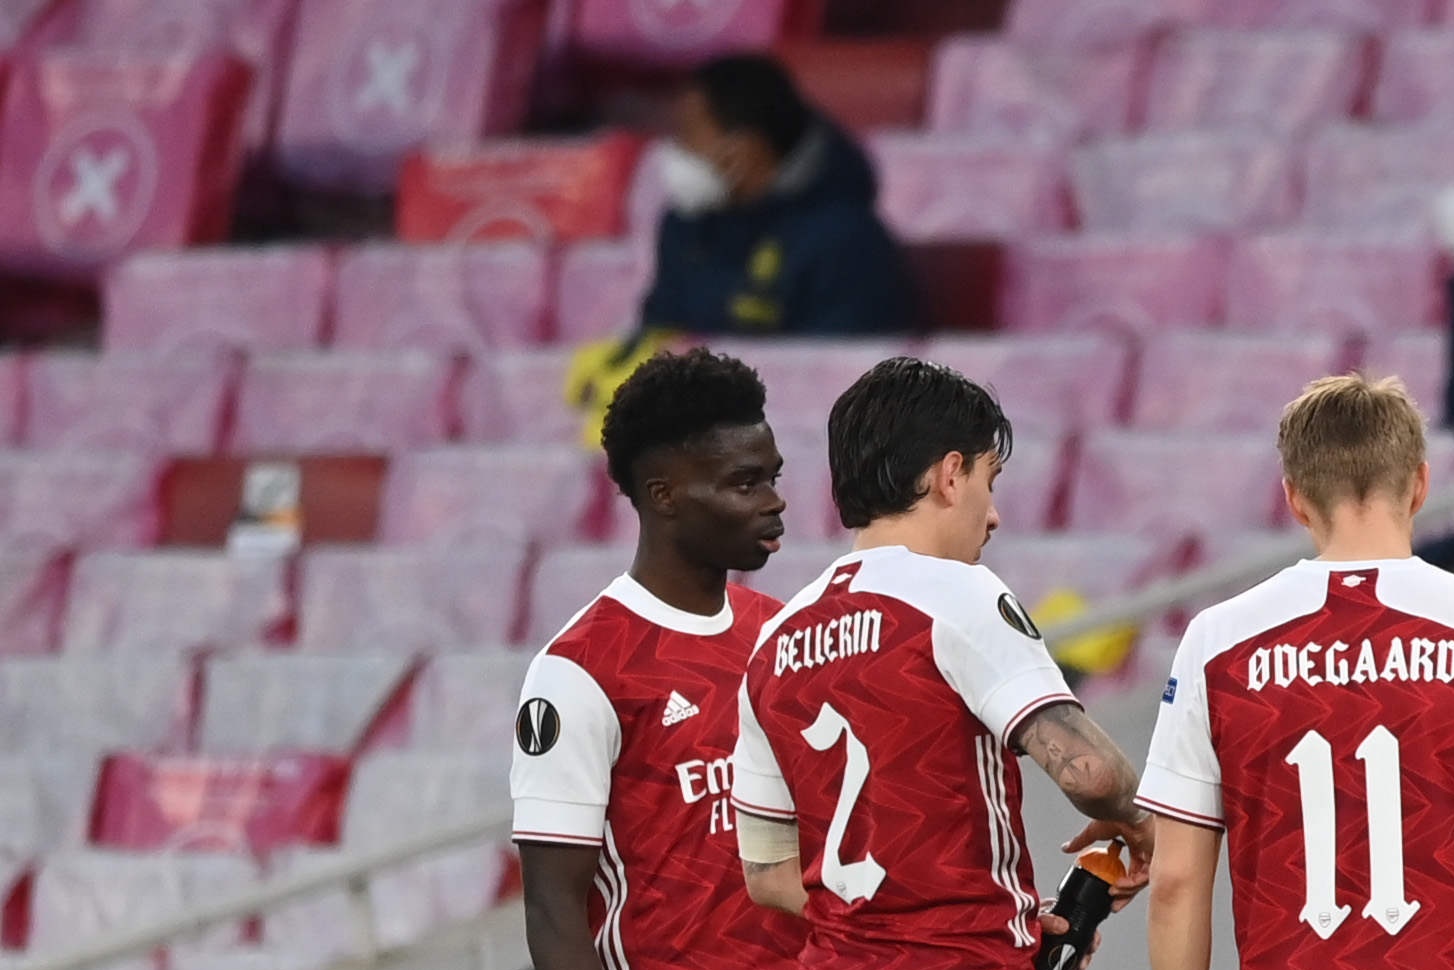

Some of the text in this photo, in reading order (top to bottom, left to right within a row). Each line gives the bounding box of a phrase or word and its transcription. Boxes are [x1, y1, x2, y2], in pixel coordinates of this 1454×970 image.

[773, 608, 883, 678] BELLERIN
[661, 704, 700, 727] adidas
[800, 701, 887, 906] 2
[1284, 724, 1421, 940] 11
